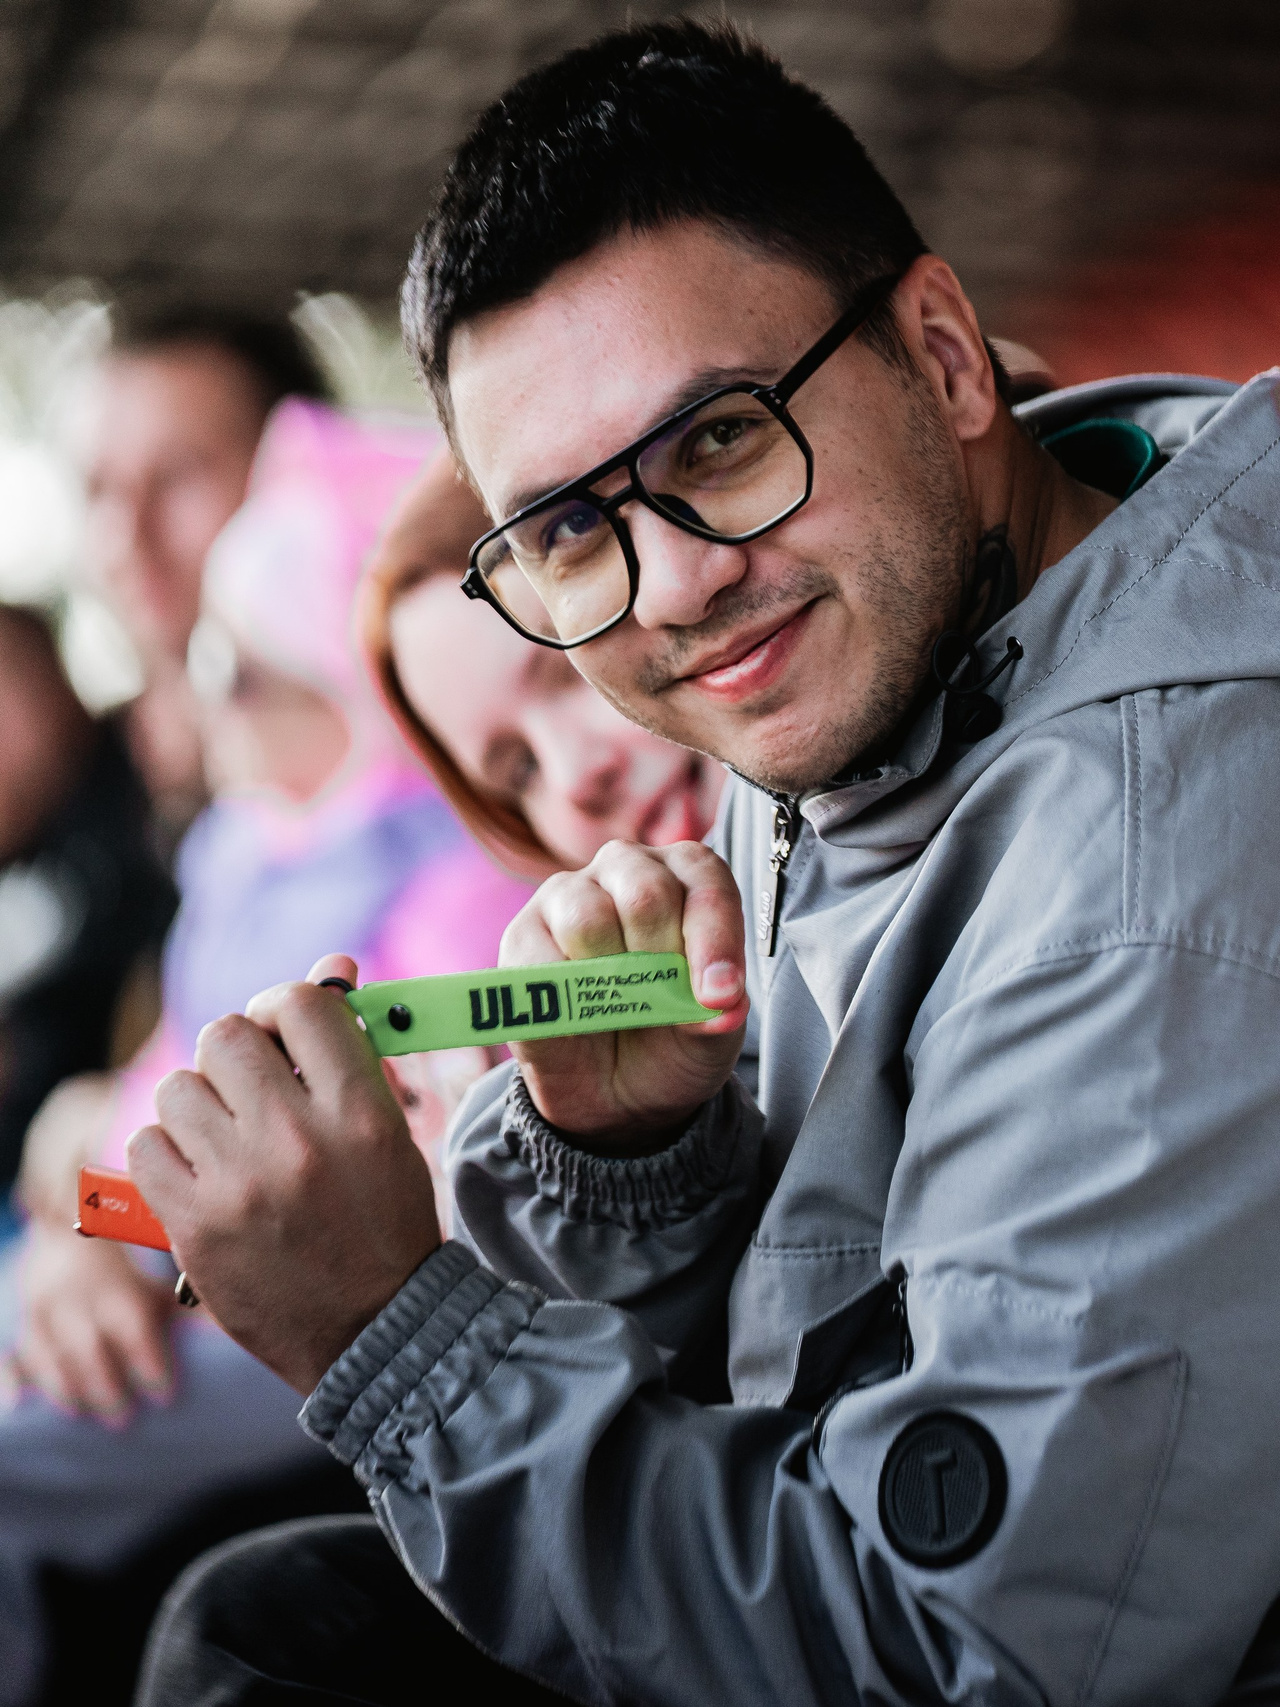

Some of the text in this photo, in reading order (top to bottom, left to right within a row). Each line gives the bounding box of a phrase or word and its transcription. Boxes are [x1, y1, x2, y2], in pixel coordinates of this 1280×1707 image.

[574, 967, 678, 988] УРАЛЬСКАЯ
[577, 988, 622, 1002] ЛИГА
[468, 980, 561, 1032] ULD
[579, 1001, 652, 1020] ДРИФТА
